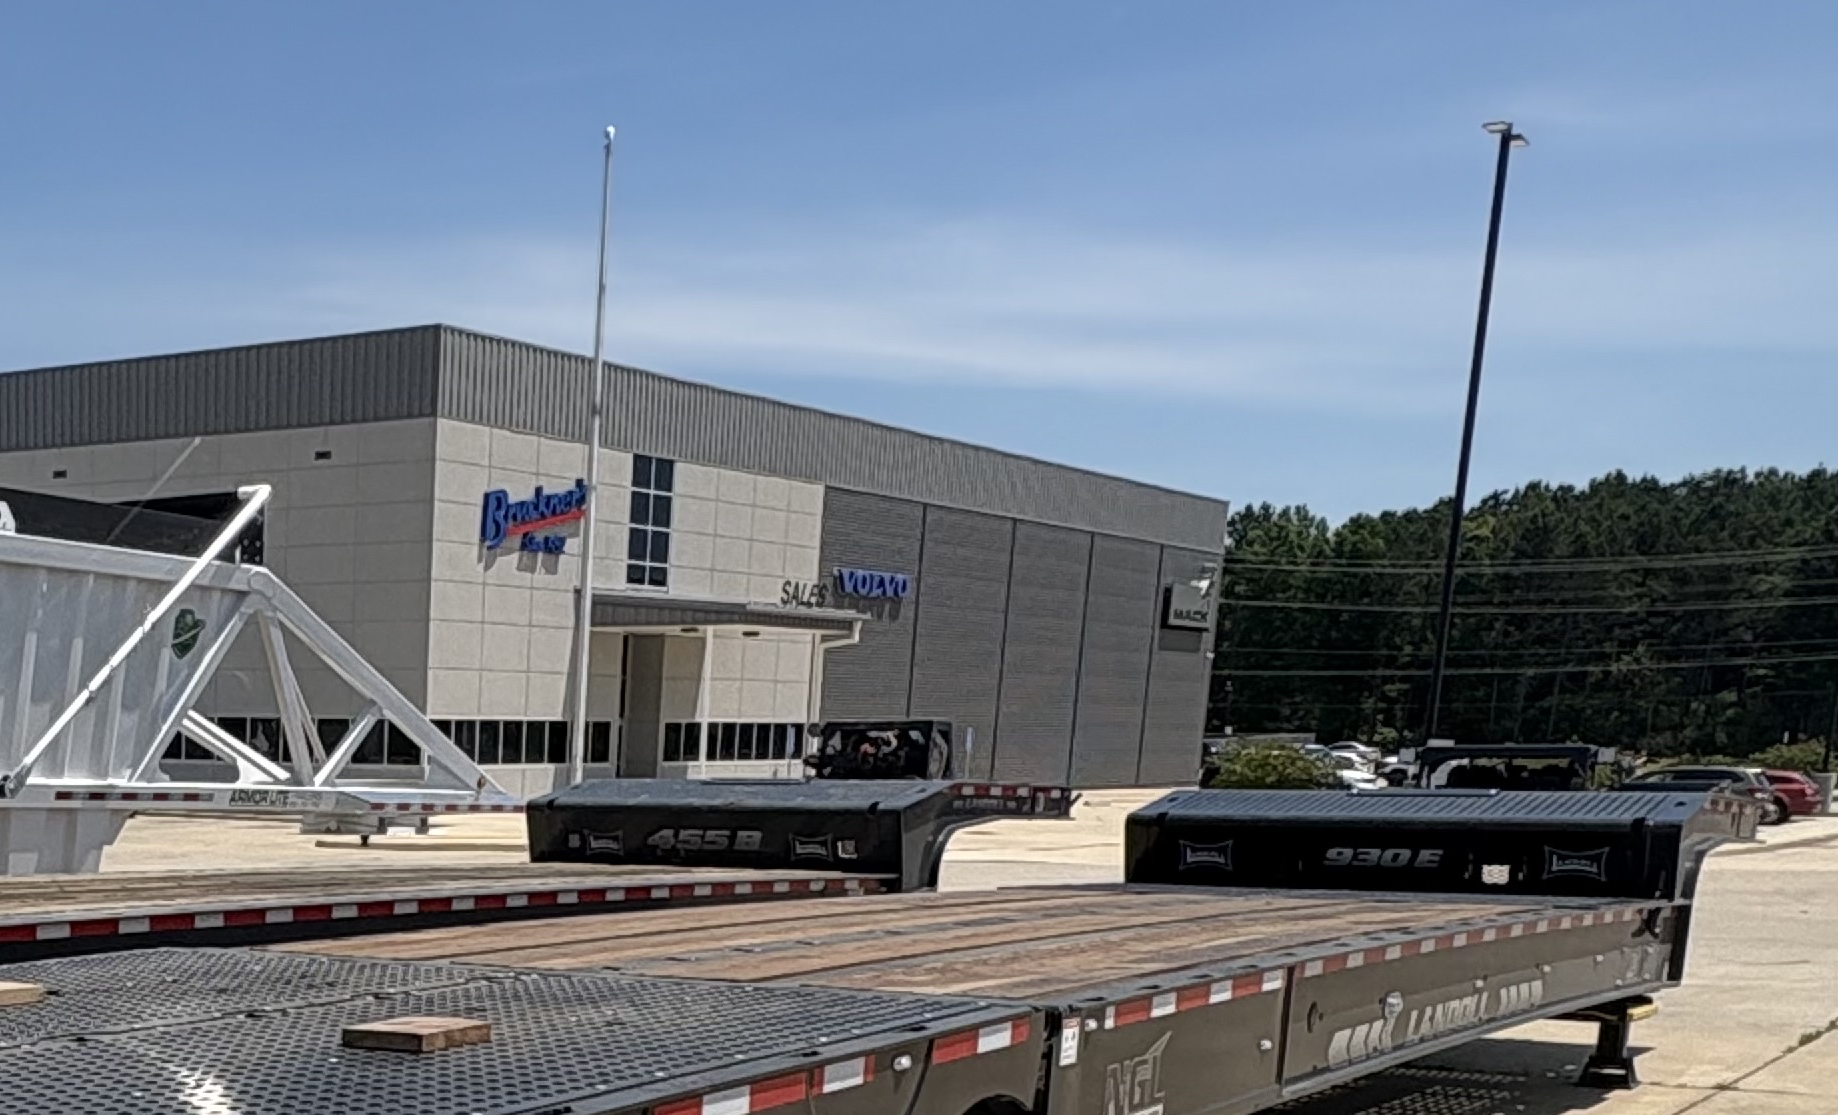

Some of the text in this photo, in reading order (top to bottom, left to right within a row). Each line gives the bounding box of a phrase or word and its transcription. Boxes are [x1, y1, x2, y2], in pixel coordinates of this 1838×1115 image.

[781, 580, 829, 608] SALES
[836, 568, 910, 598] VOLVO
[647, 828, 731, 850] 455
[1324, 847, 1444, 867] 930 E
